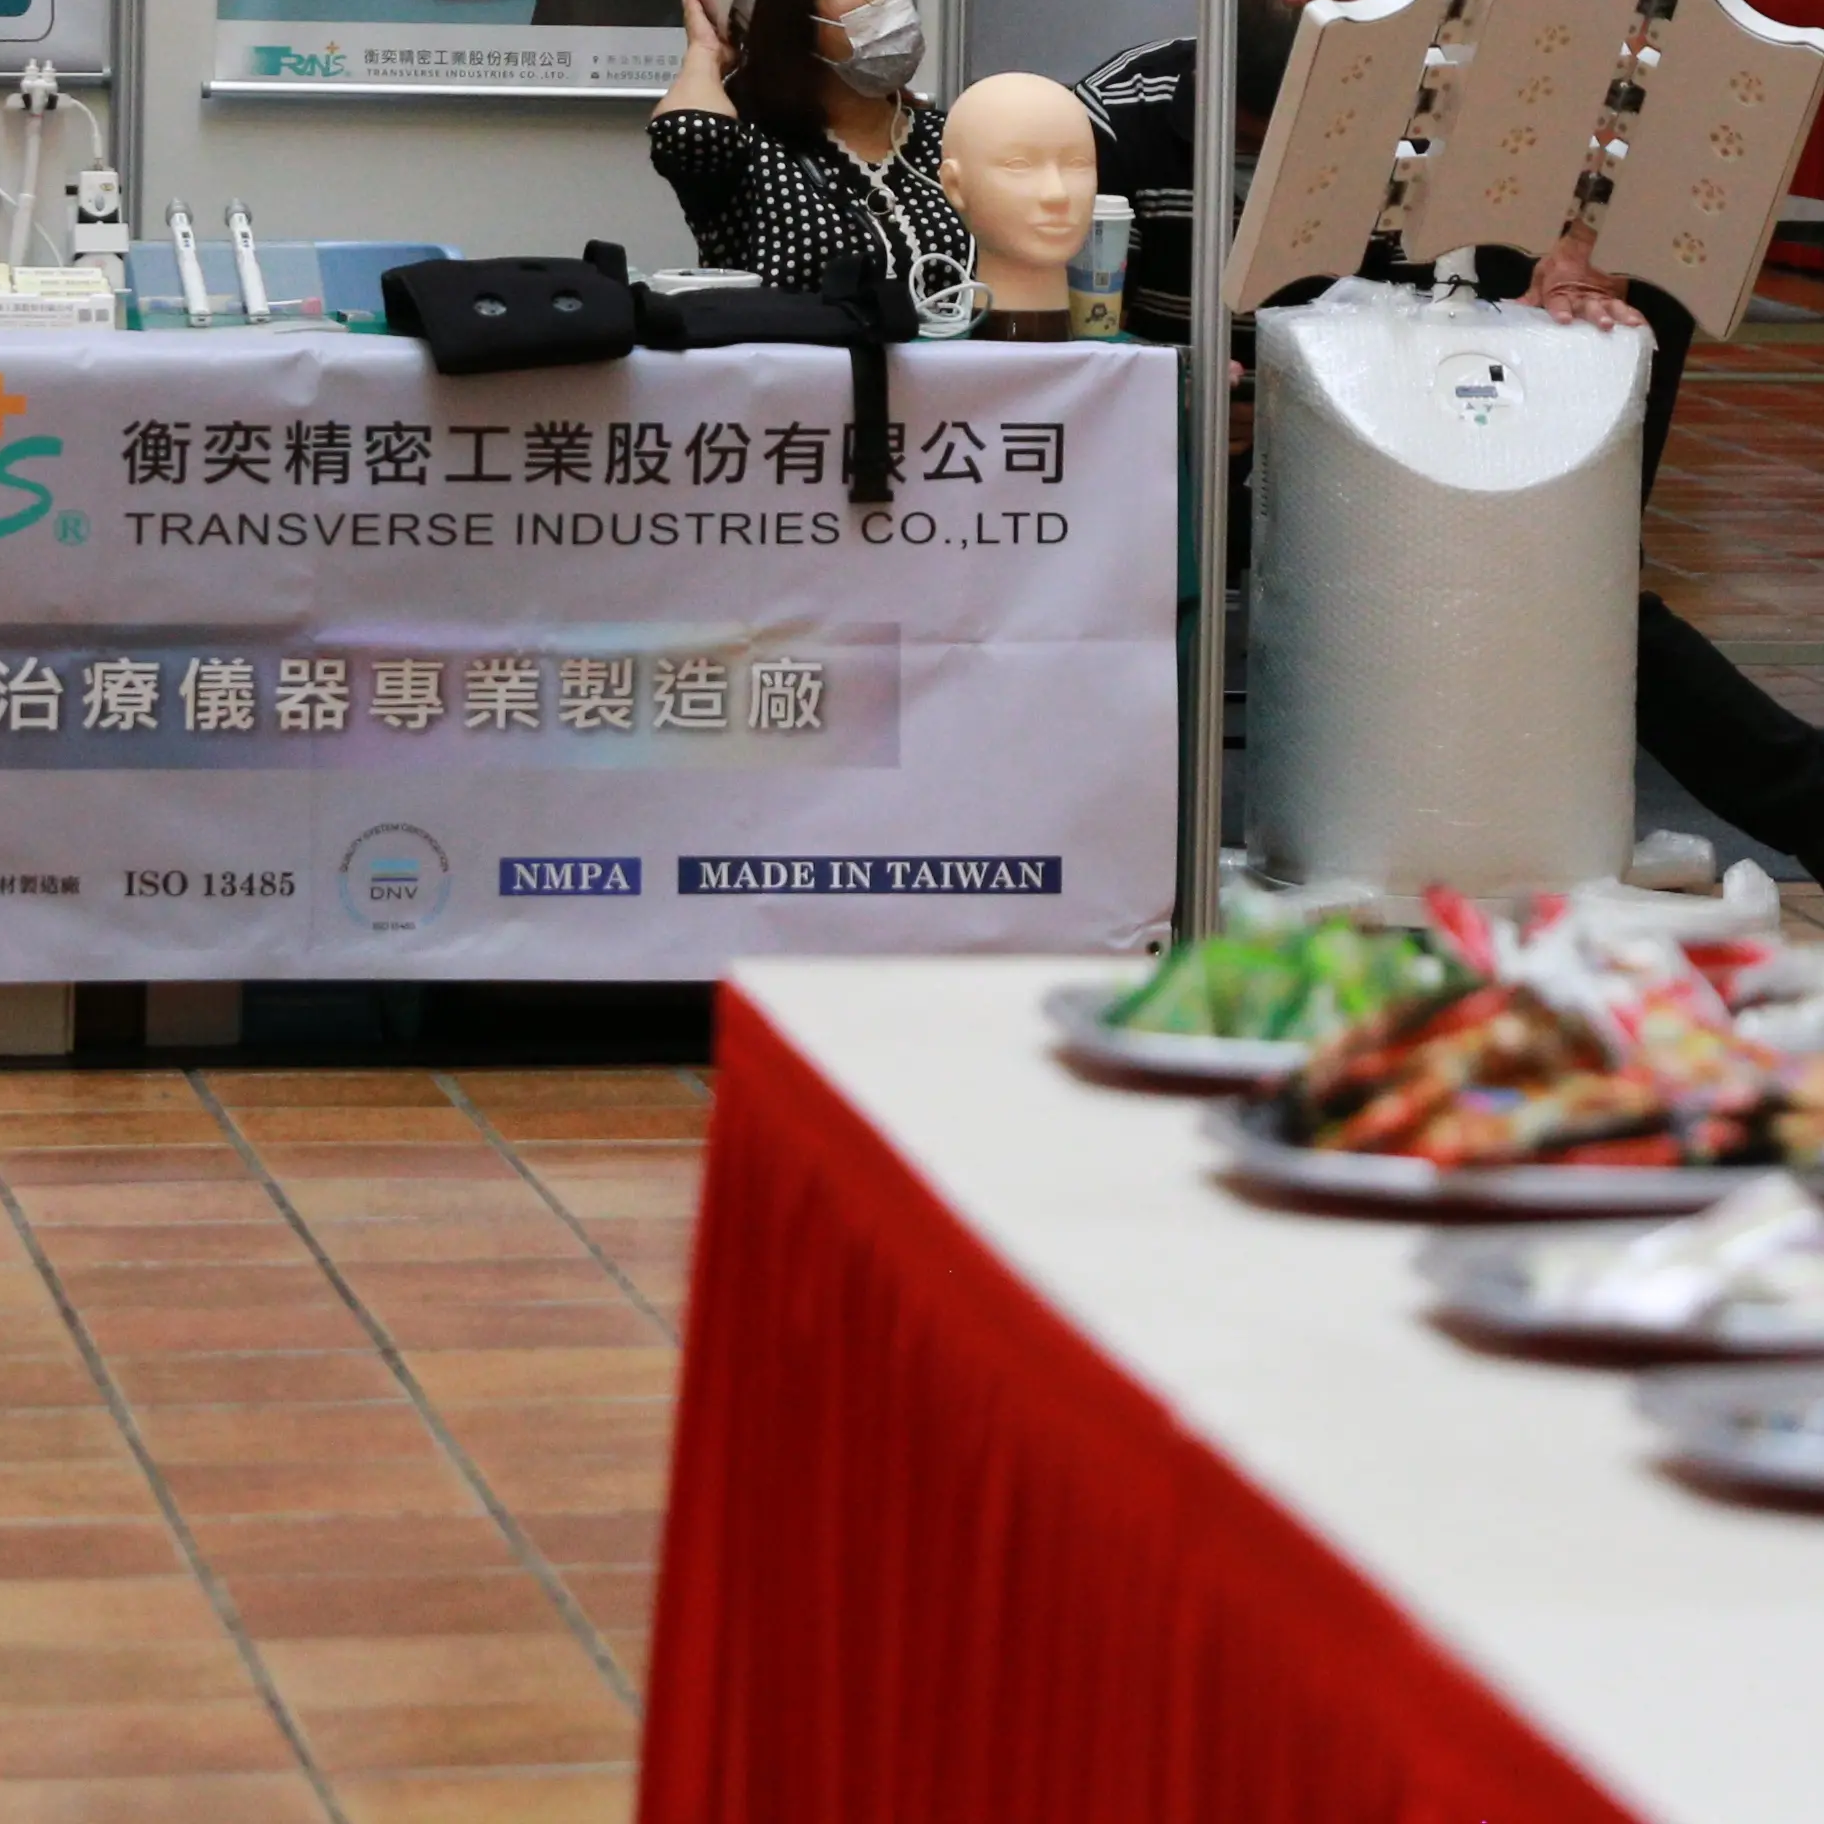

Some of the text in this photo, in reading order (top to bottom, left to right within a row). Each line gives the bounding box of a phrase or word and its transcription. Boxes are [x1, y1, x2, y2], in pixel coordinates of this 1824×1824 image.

[364, 48, 573, 68] 衡奕精密工業股份有限公司
[125, 510, 1070, 551] TRANSVERSE INDUSTRIES CO.,LTD
[123, 869, 297, 899] ISO 13485
[511, 861, 632, 891] NMPA
[698, 860, 1046, 890] MADE IN TAIWAN
[370, 884, 418, 901] DNV
